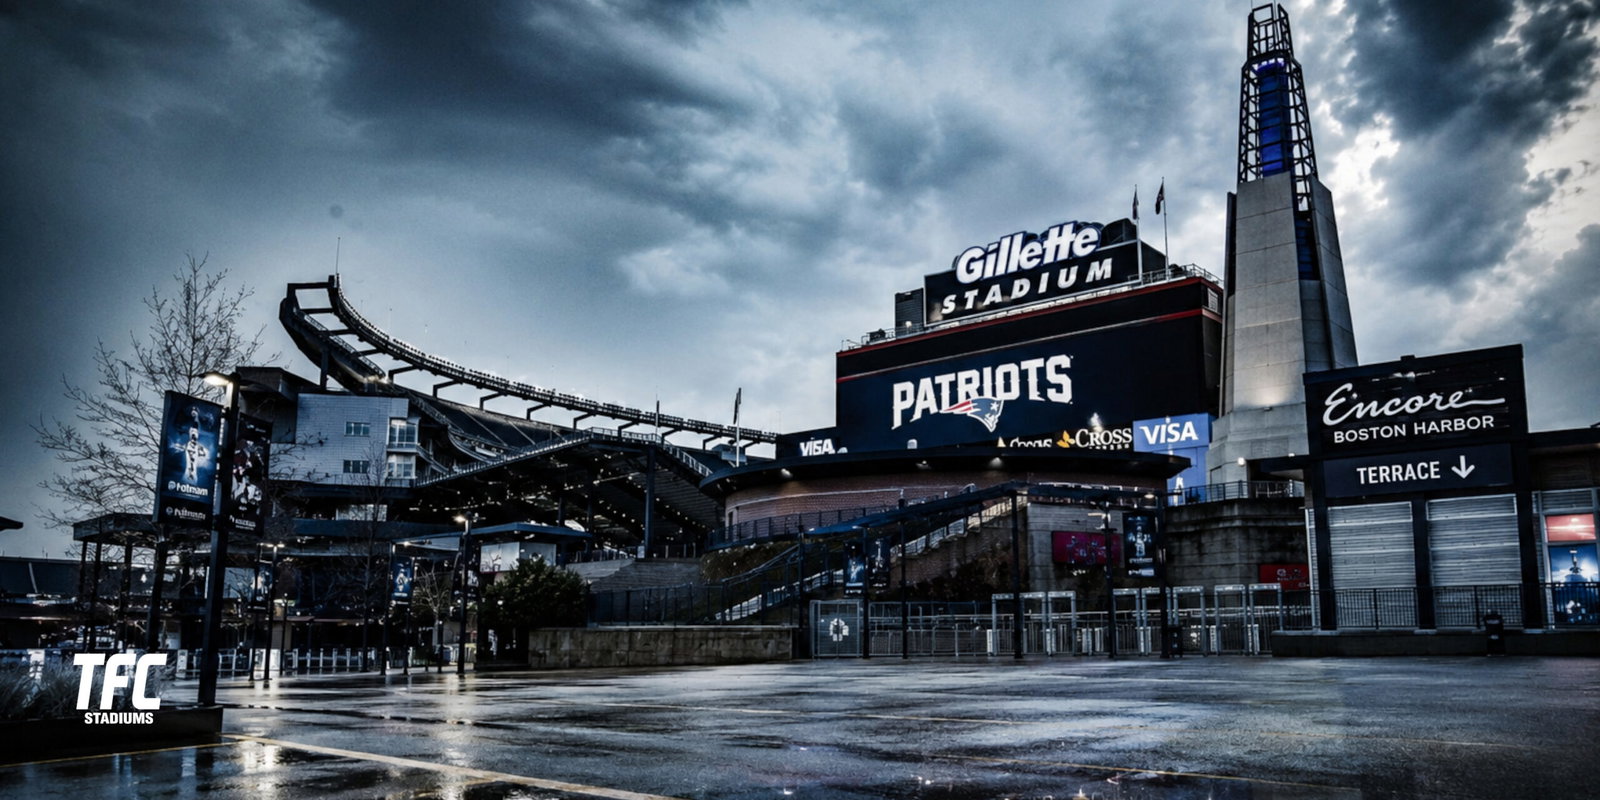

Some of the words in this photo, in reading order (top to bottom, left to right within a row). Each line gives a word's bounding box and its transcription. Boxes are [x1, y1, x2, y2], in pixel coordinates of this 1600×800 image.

[956, 222, 1100, 284] Gillette
[941, 258, 1113, 315] STADIUM
[891, 354, 1073, 430] PATRIOTS
[1322, 382, 1506, 426] Encore
[1075, 428, 1133, 448] CROSS
[1139, 420, 1199, 445] VISA
[1333, 424, 1407, 444] BOSTON
[1413, 415, 1495, 435] HARBOR
[1356, 460, 1442, 485] TERRACE
